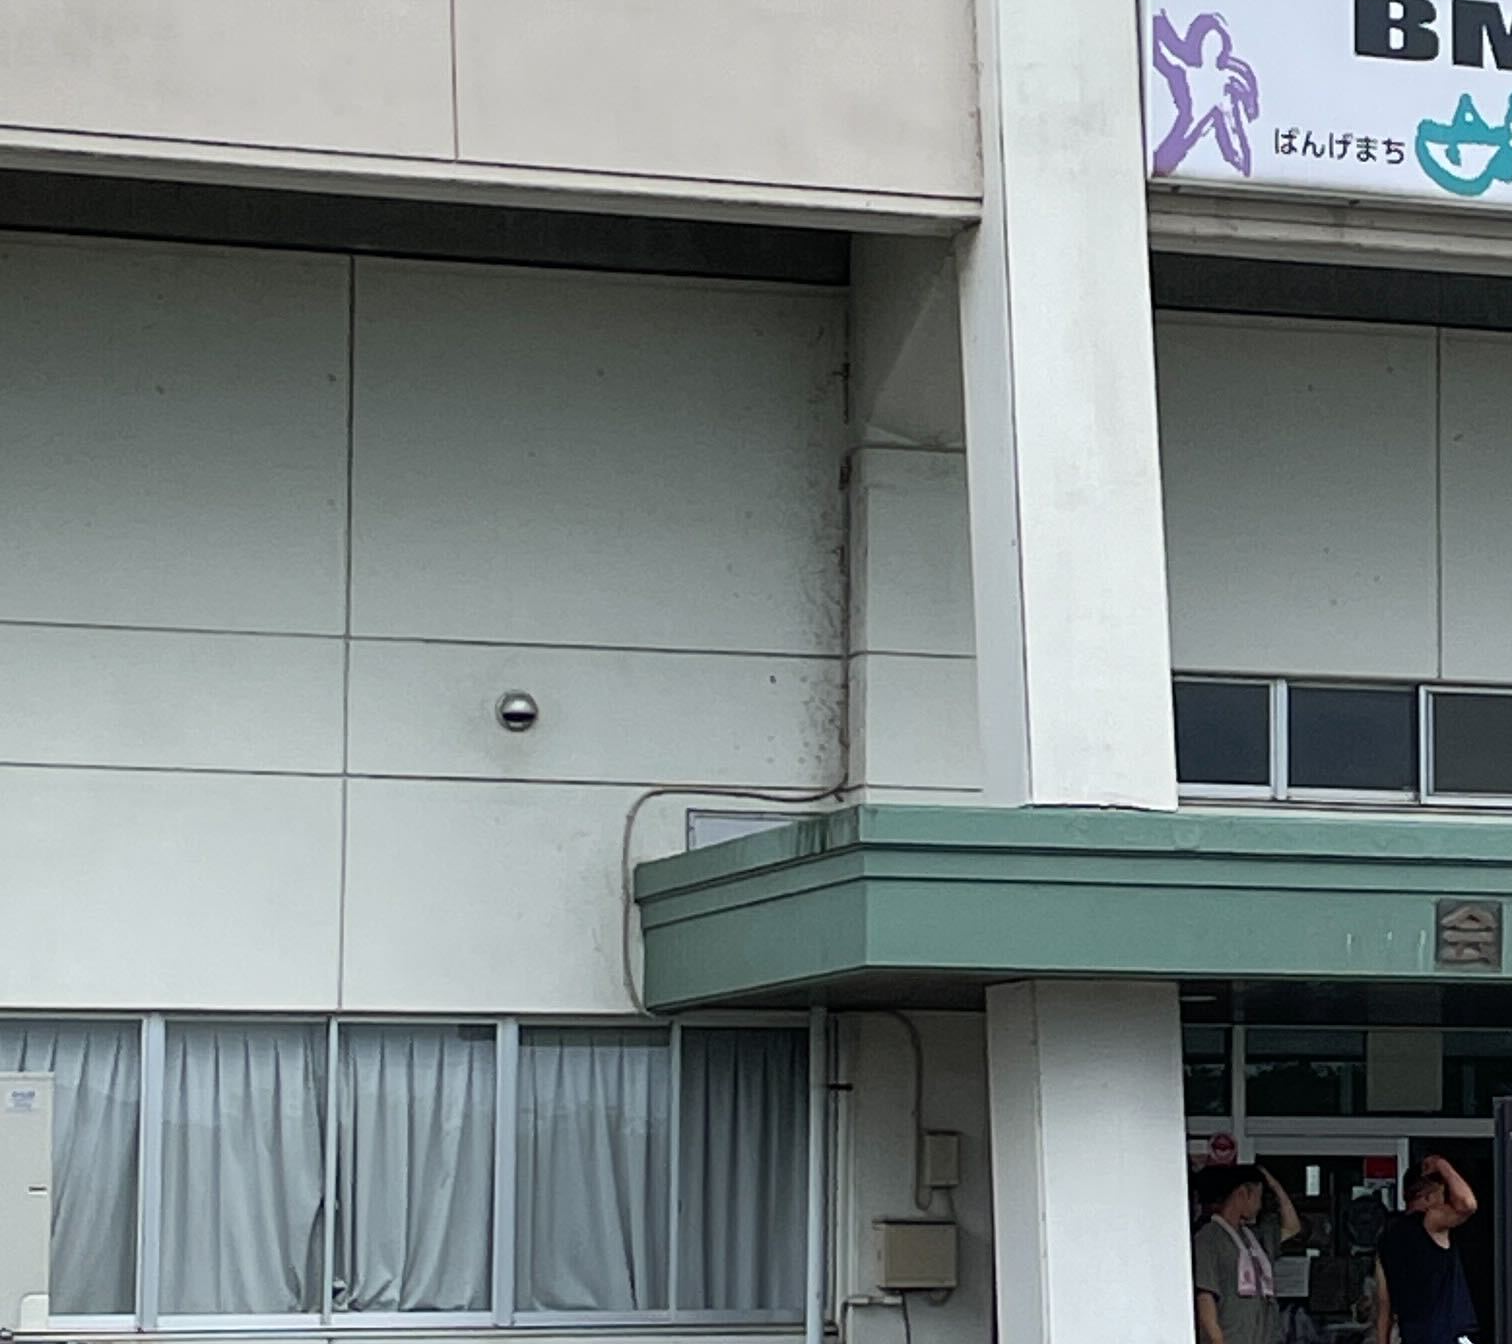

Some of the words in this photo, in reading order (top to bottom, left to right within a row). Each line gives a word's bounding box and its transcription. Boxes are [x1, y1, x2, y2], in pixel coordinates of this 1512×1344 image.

[1274, 126, 1405, 164] ばんげまち
